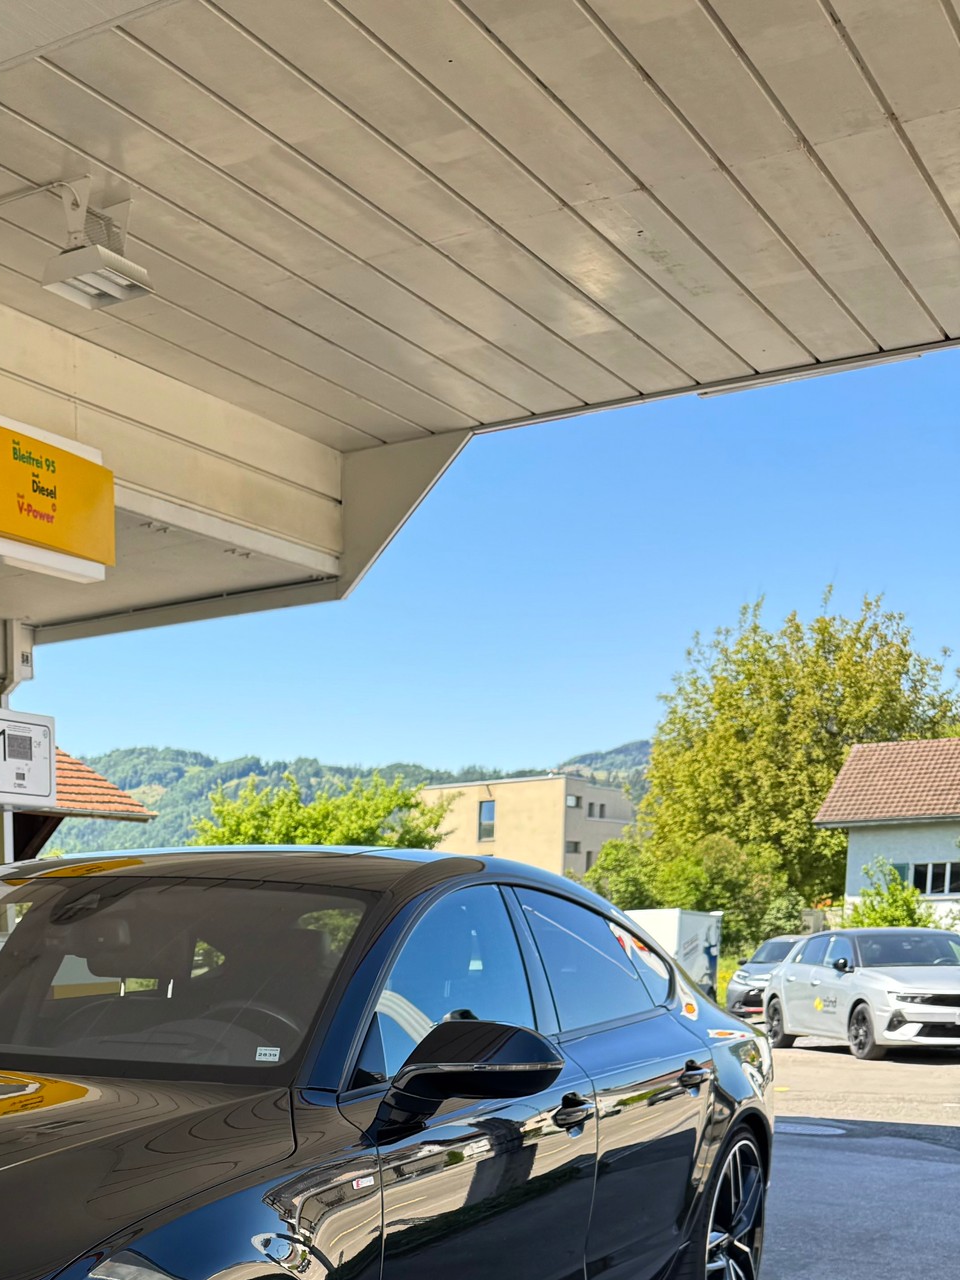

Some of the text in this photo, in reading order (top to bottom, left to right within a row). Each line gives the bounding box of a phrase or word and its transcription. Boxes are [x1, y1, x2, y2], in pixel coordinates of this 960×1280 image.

[12, 446, 56, 474] Bleifrei 95
[32, 479, 57, 500] Diesel
[17, 499, 55, 525] V-Power
[0, 728, 7, 762] 1
